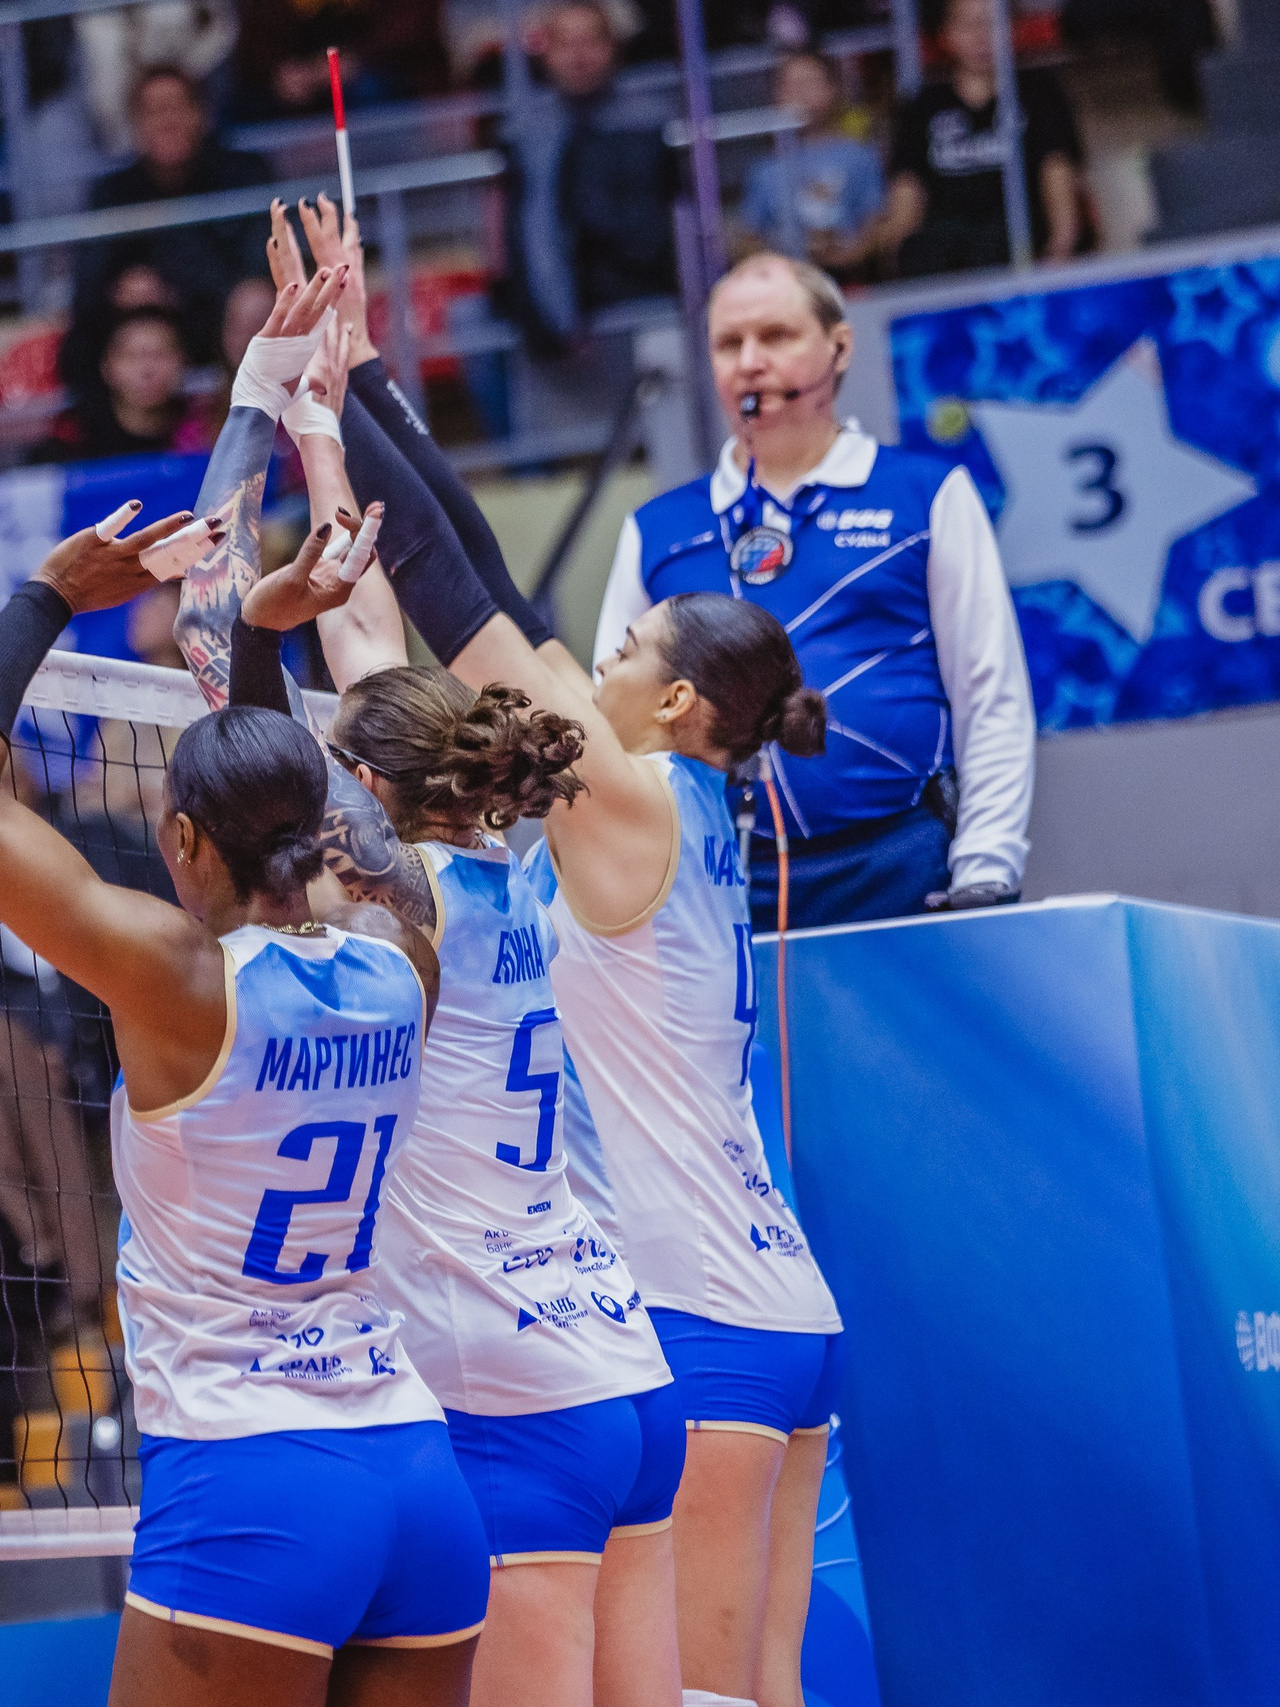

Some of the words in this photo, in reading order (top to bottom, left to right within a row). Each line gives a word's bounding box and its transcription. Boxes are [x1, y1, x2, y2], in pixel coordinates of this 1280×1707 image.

[1064, 442, 1126, 536] 3
[733, 923, 757, 1087] 4
[255, 1021, 416, 1092] МАРТИНЕС
[496, 1007, 559, 1172] 5
[242, 1114, 398, 1286] 21
[527, 1200, 552, 1215] ENSEN
[486, 1242, 514, 1254] Банк
